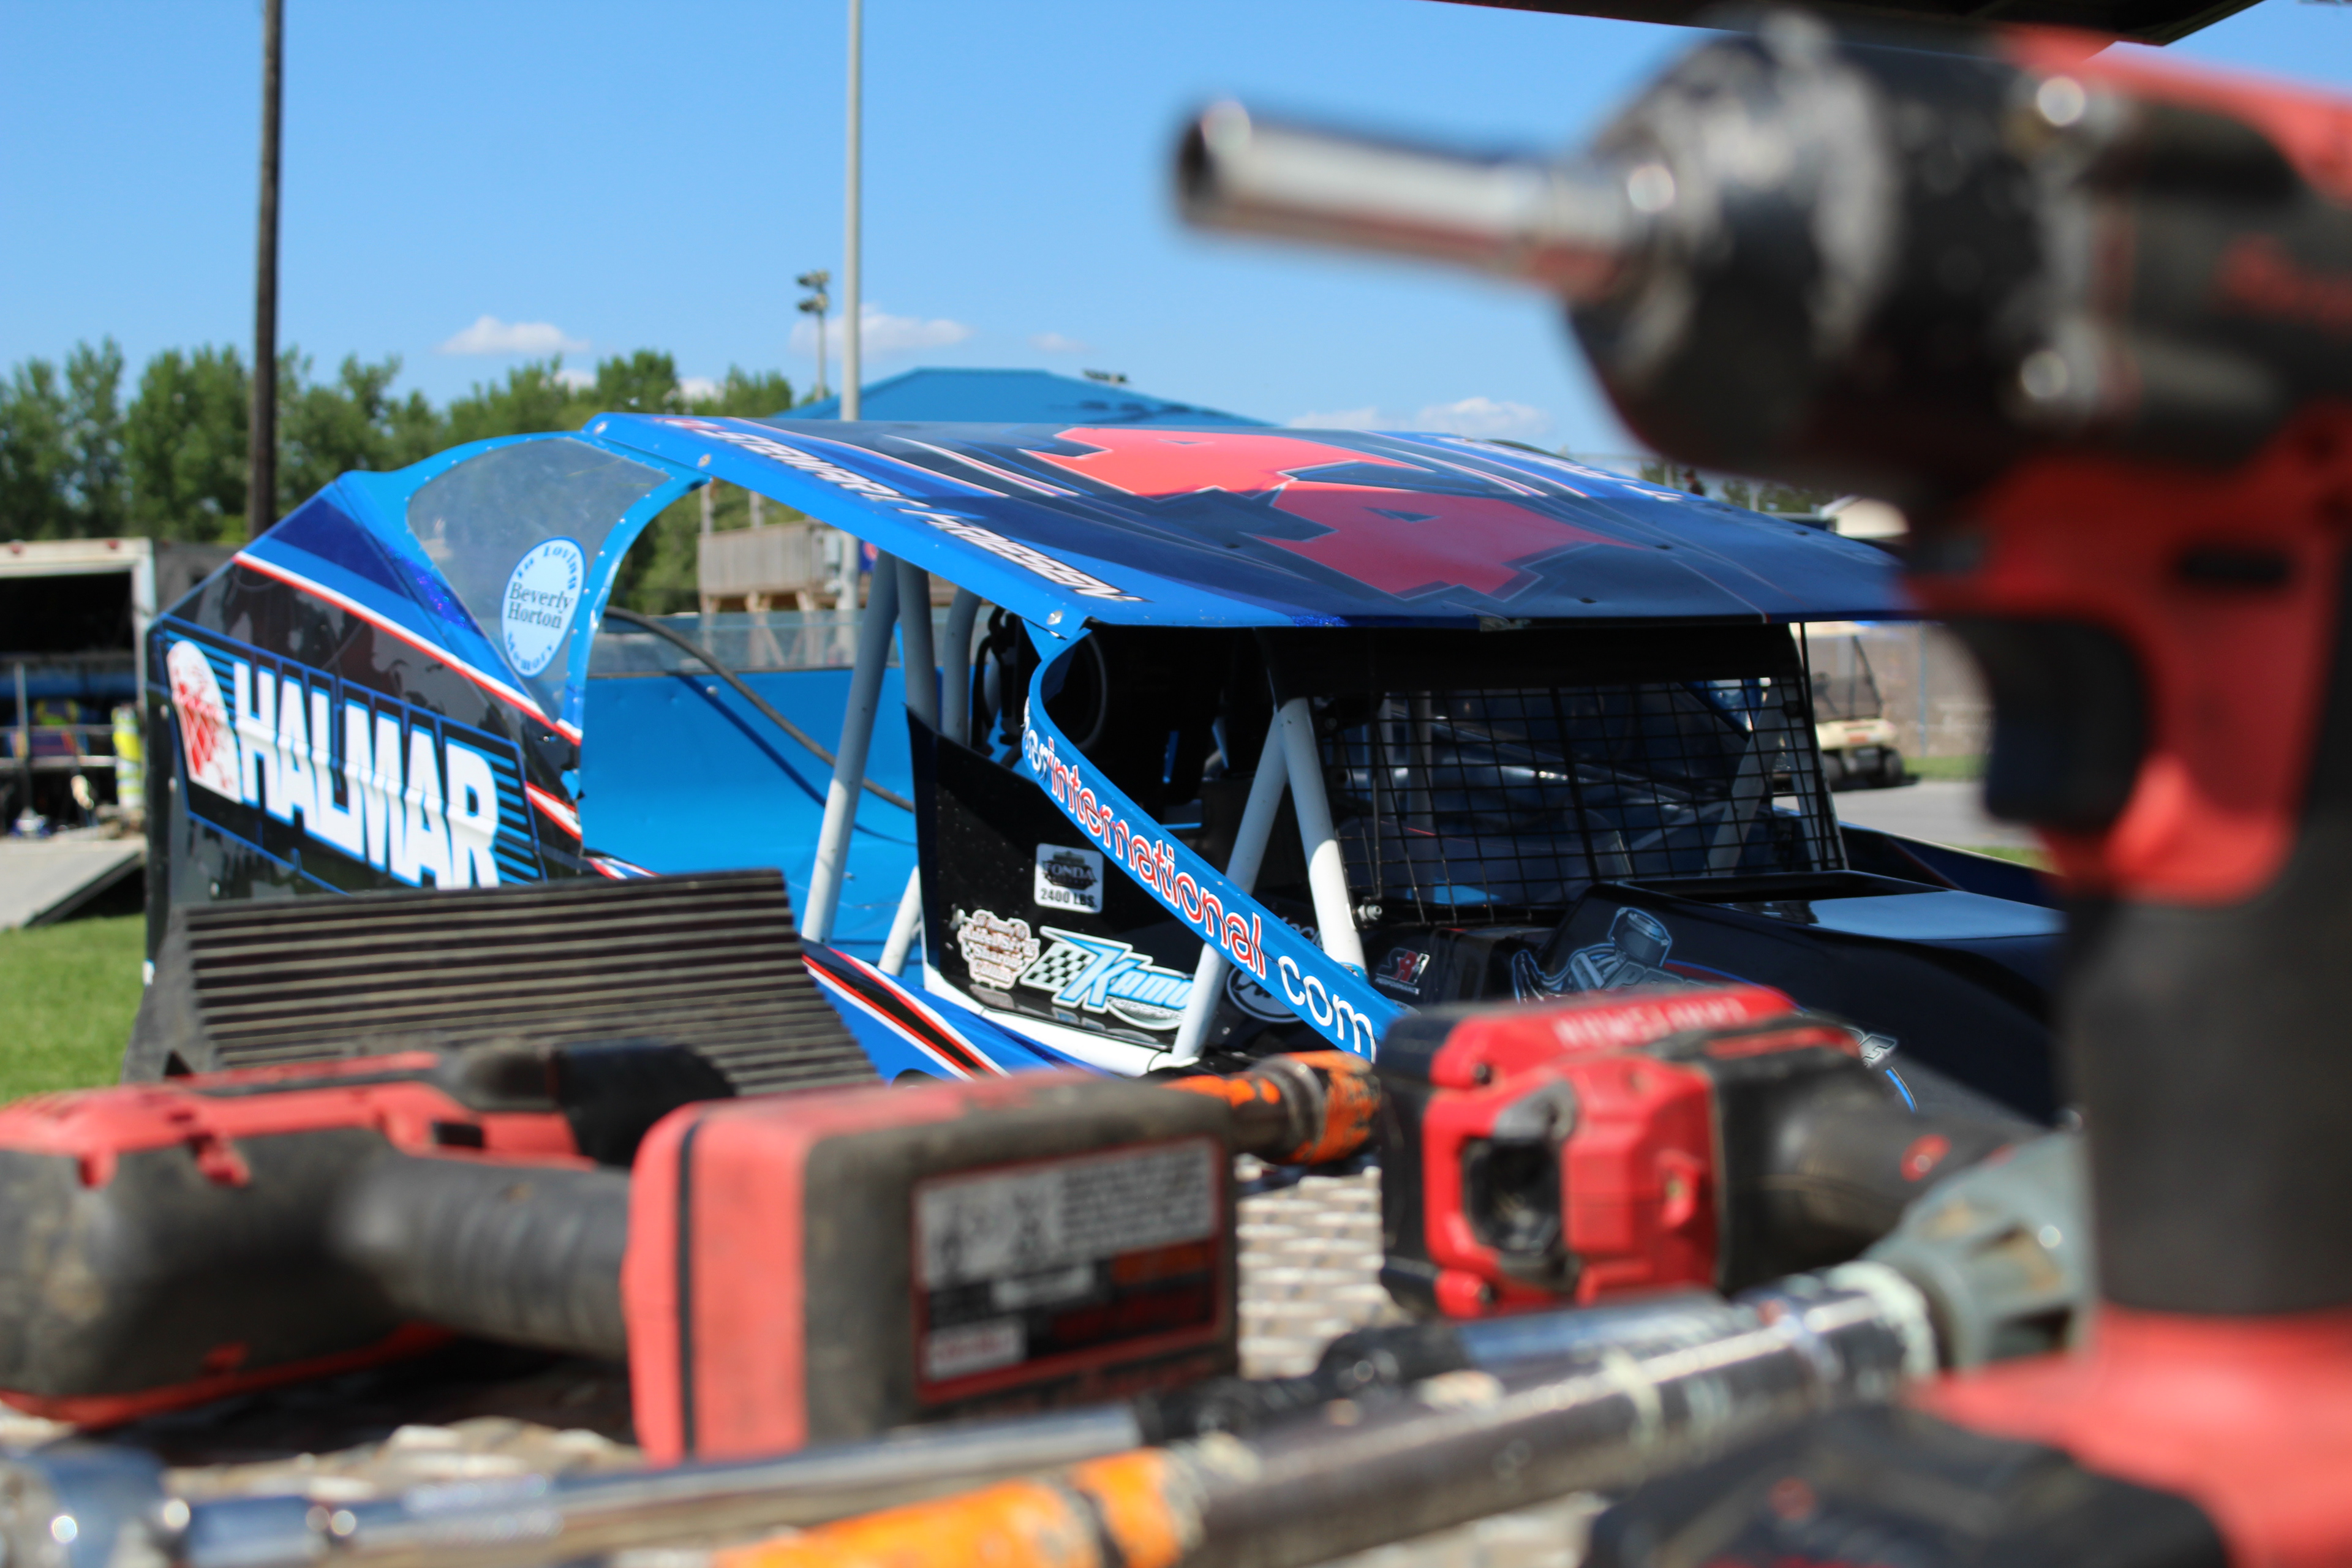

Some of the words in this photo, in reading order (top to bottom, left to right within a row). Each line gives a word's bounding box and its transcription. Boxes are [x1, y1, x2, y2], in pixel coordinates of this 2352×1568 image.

[897, 508, 1152, 603] FRIESEN
[509, 582, 574, 614] Beverly
[507, 601, 563, 629] Horton
[233, 660, 501, 891] HALMAR
[1042, 861, 1097, 883] FONDA
[1041, 888, 1070, 903] 2400
